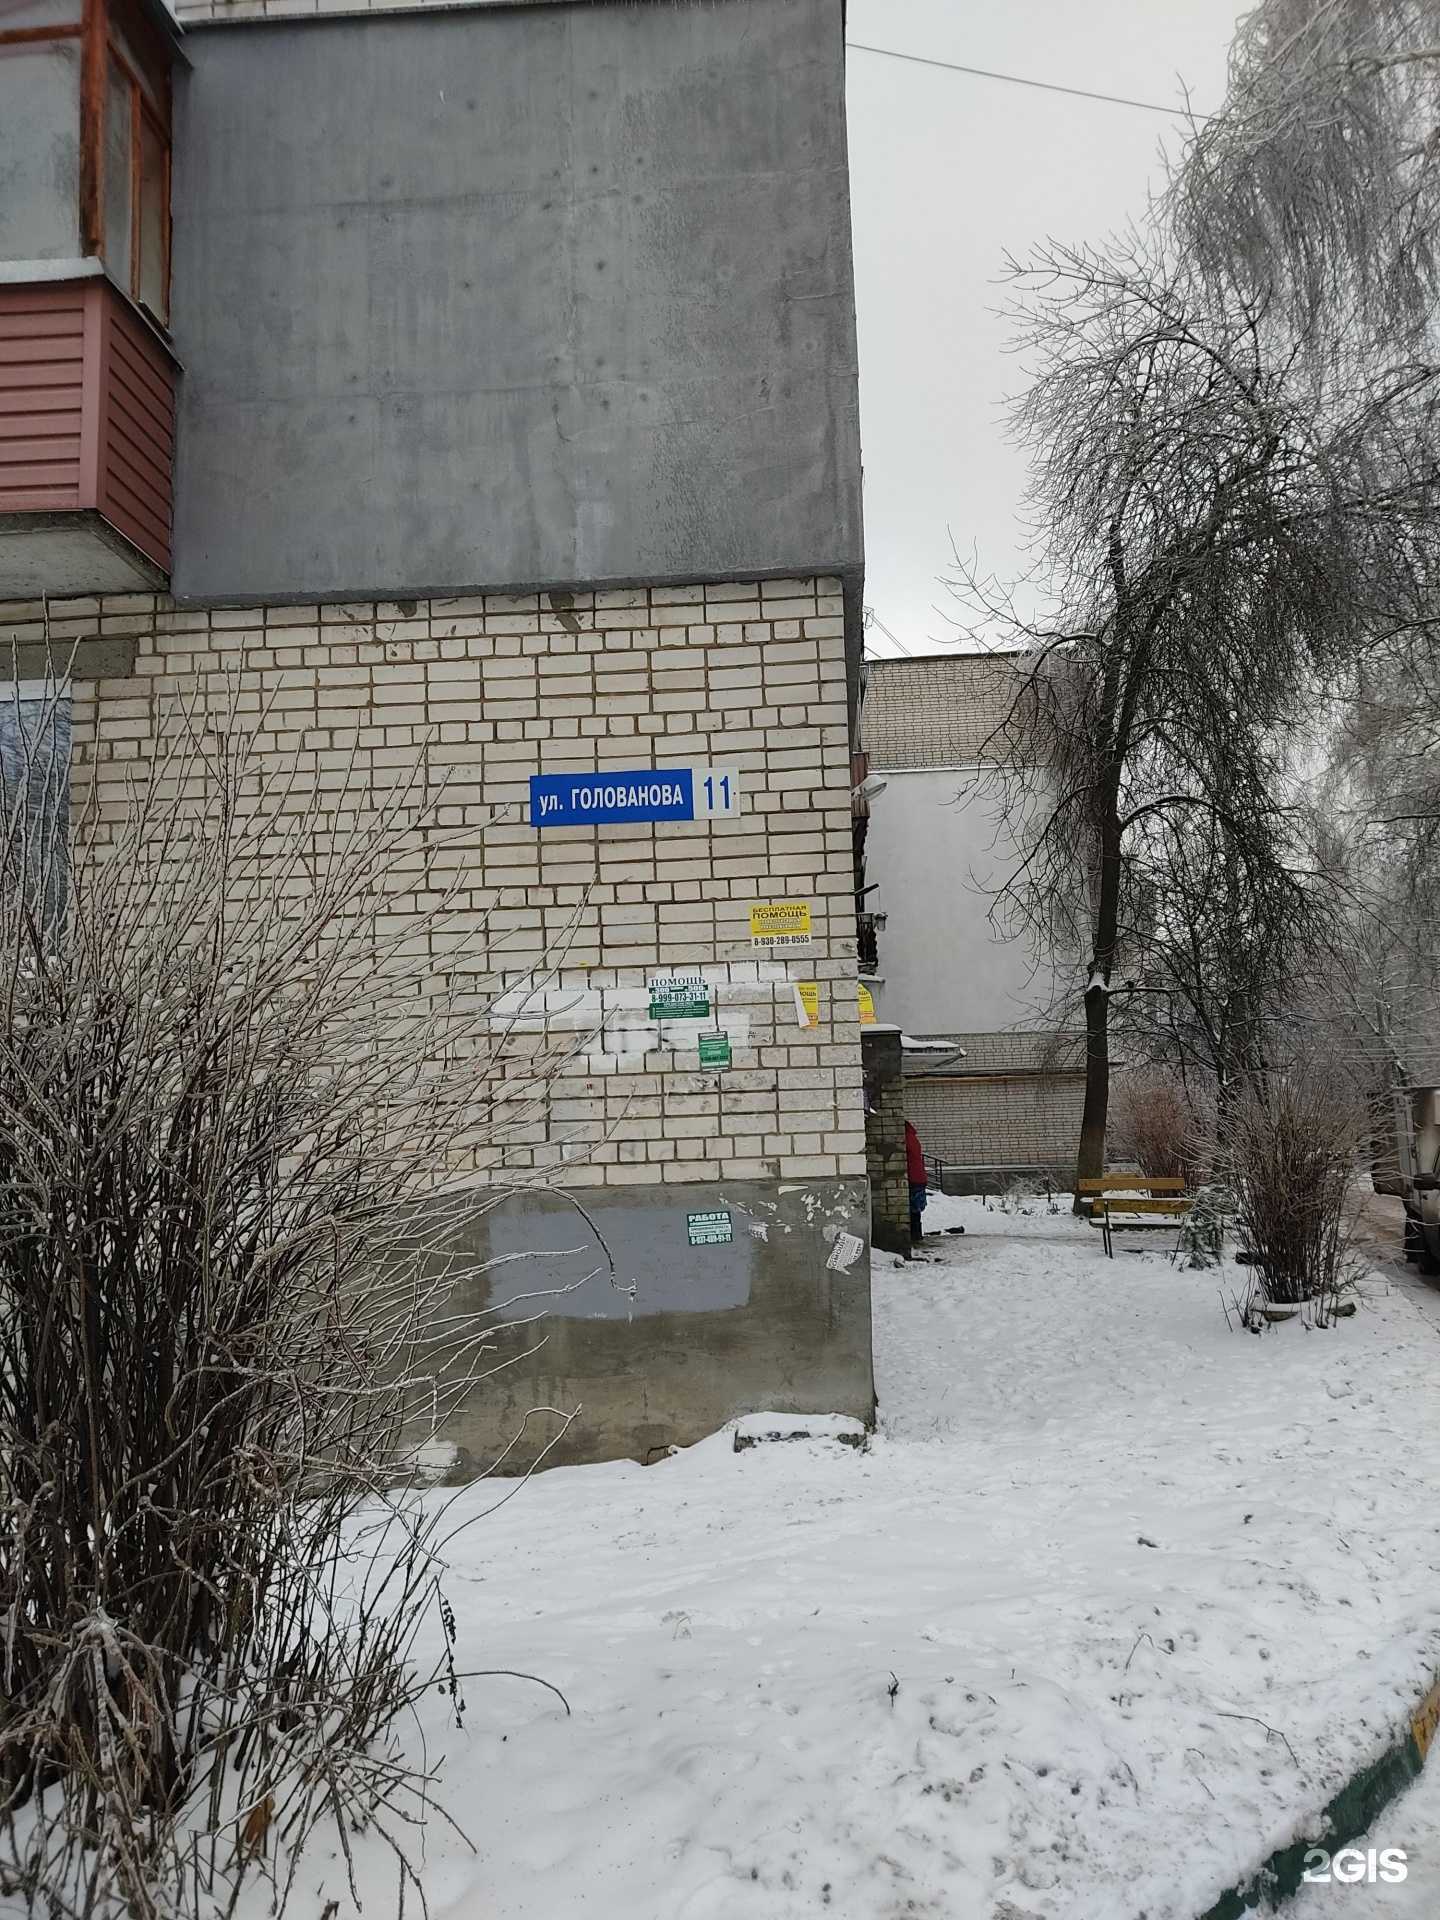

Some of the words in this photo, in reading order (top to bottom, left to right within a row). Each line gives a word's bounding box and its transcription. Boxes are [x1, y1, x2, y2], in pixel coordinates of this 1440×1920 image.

[539, 794, 563, 816] ул.
[571, 784, 684, 810] ГОЛОВАНОВА
[703, 775, 731, 810] 11
[752, 911, 807, 919] ПОМОЩЬ
[651, 977, 706, 987] ПОМОЩЬ
[688, 1213, 730, 1222] РАБОТА
